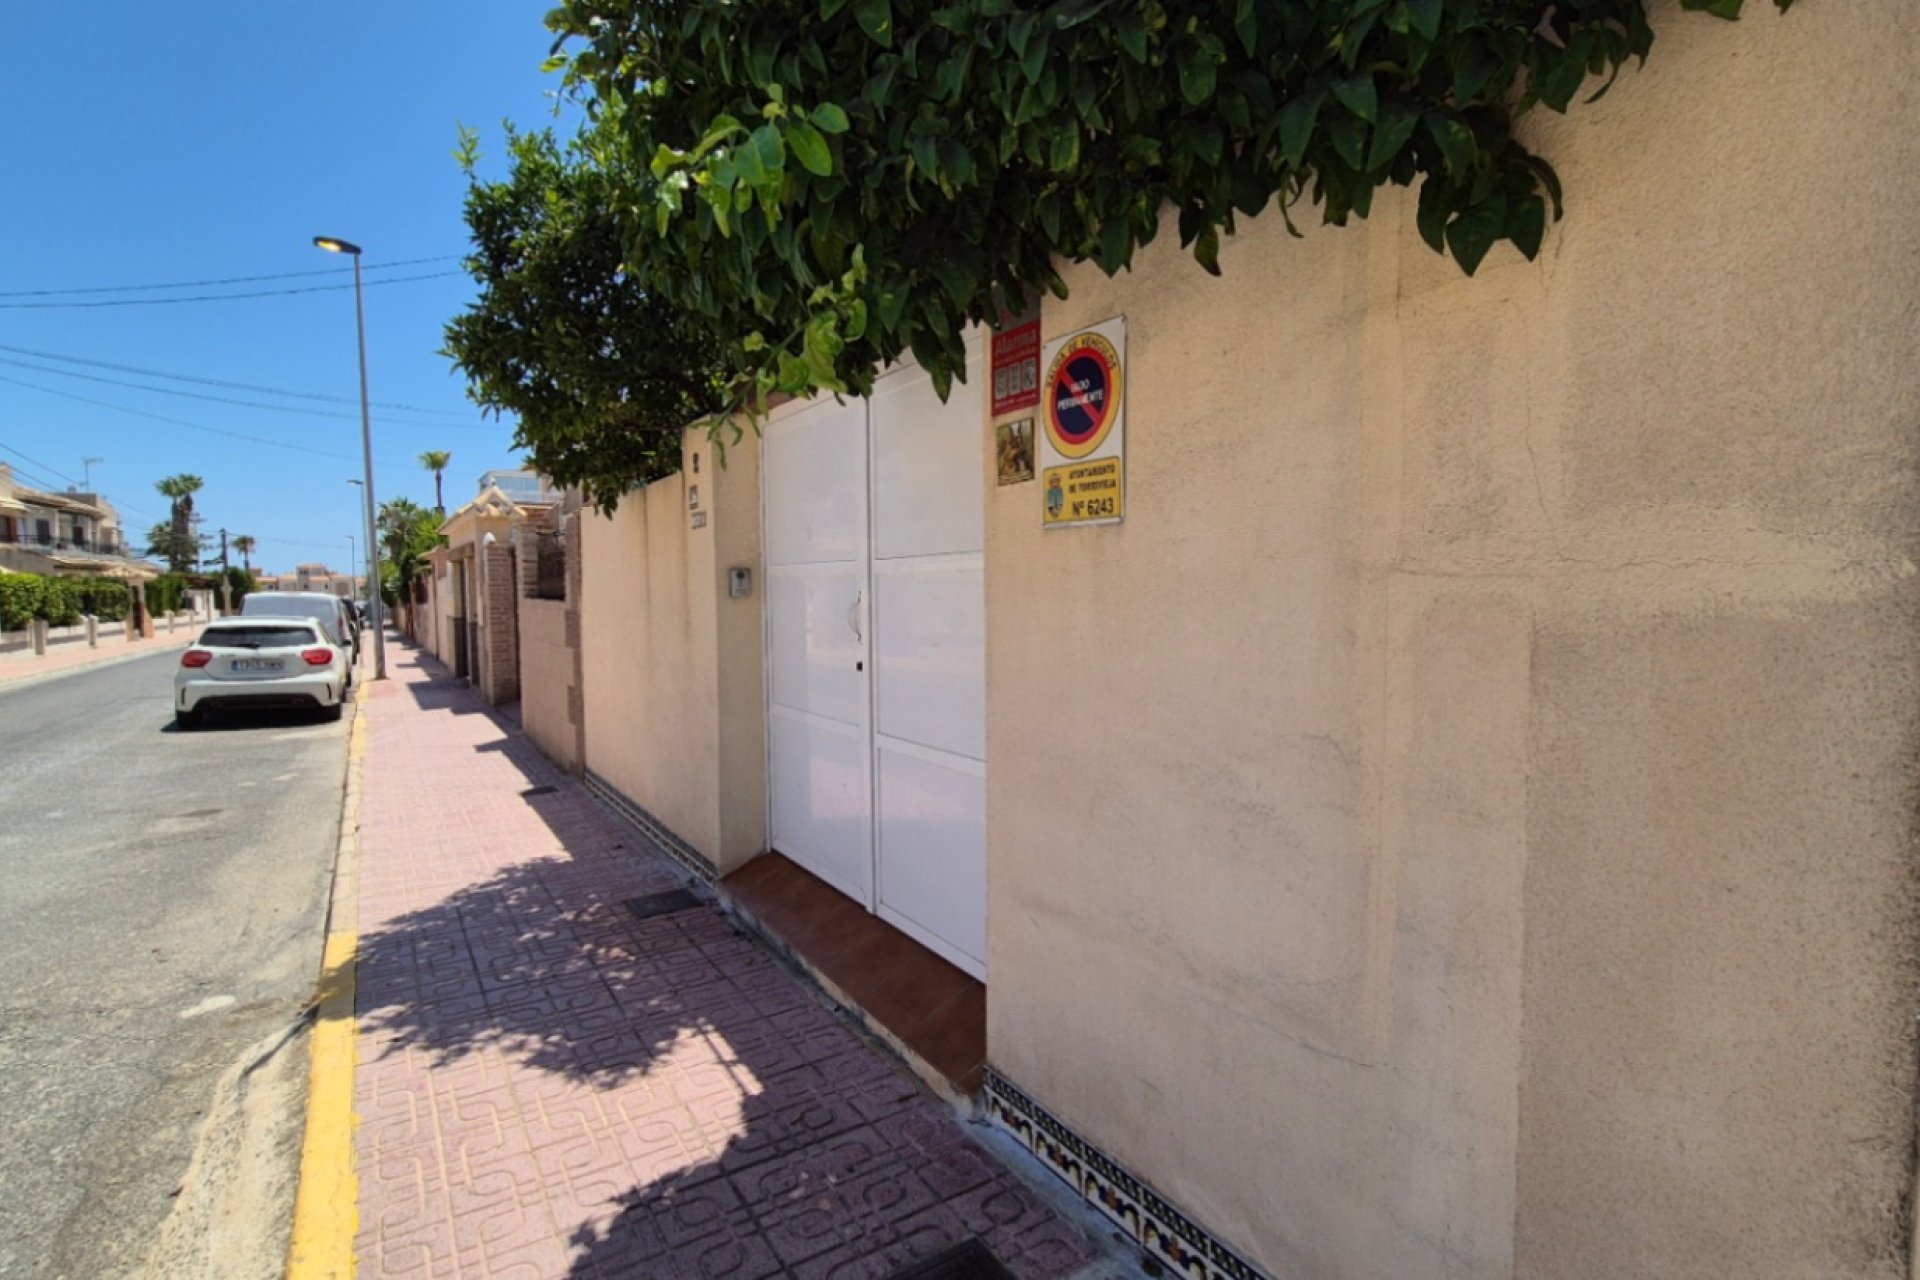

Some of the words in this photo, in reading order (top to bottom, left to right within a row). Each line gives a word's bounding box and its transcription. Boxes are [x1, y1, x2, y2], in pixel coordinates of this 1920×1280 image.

[1057, 388, 1104, 411] PERMANENTE
[1069, 464, 1116, 480] AYUNTAMIENTO
[1079, 478, 1117, 491] TORREVIEJA
[1087, 497, 1114, 515] 6243
